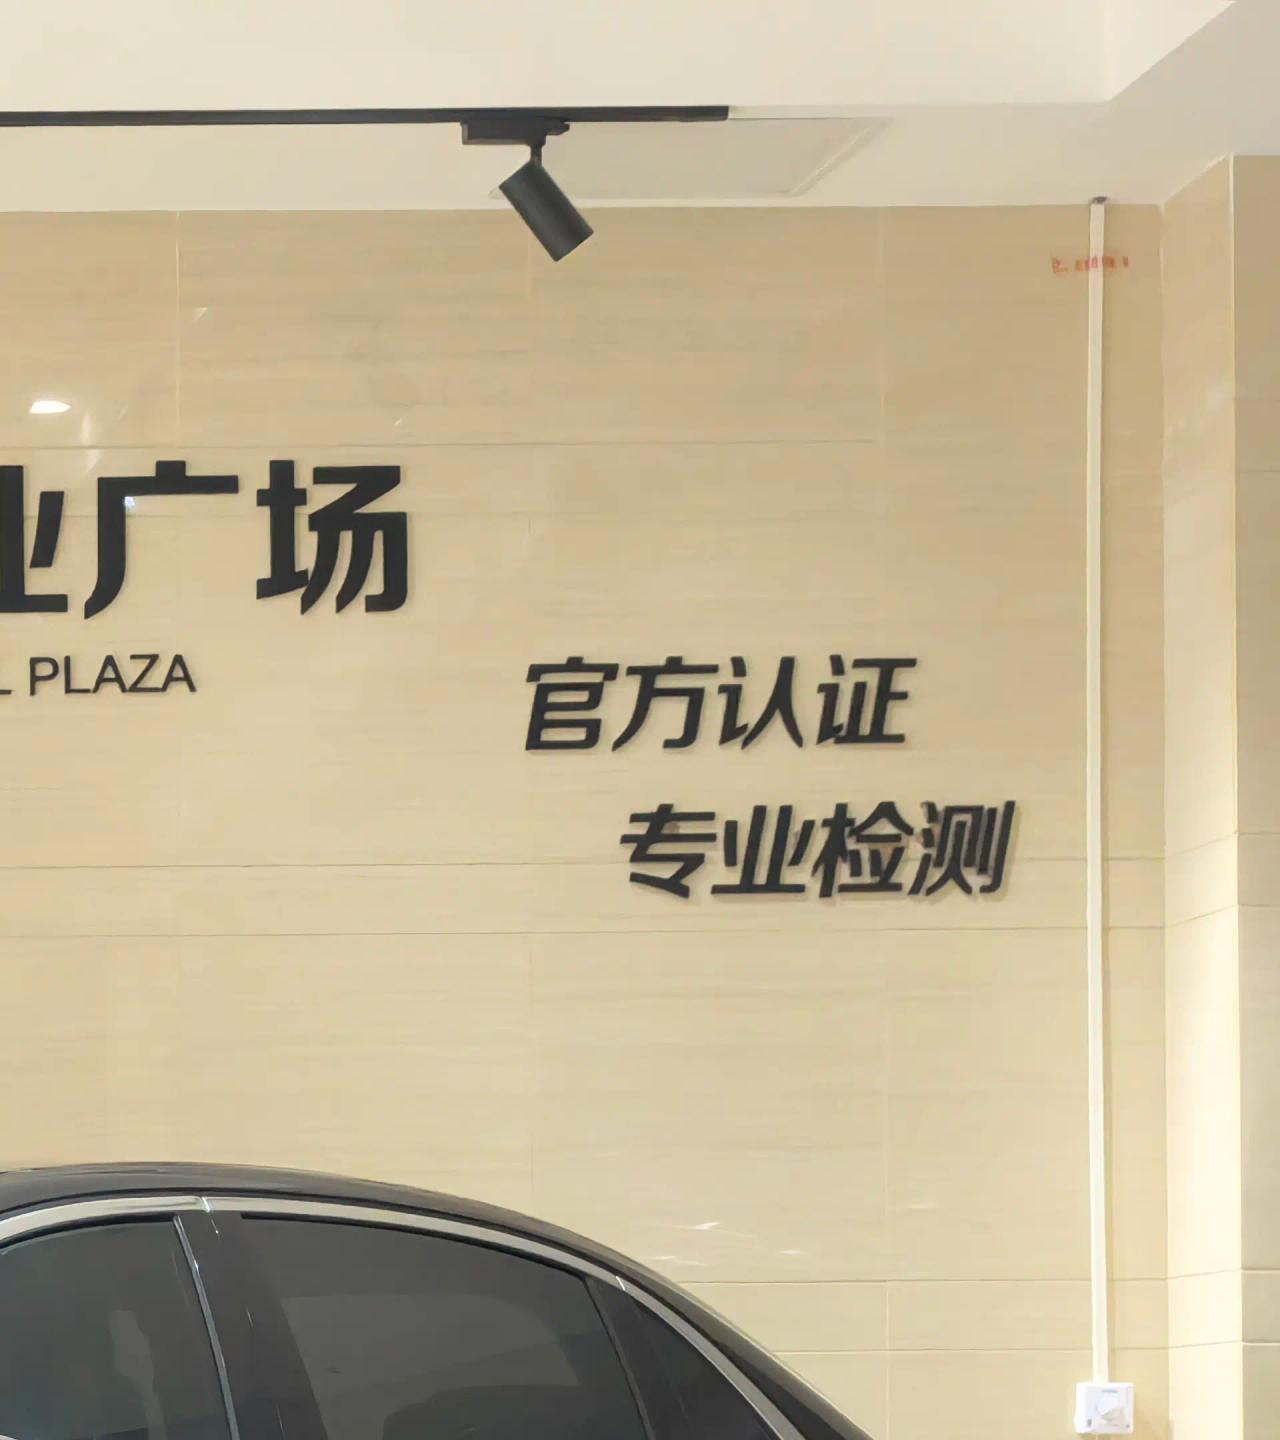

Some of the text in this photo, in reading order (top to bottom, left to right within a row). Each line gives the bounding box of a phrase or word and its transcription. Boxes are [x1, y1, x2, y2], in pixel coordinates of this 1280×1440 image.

[29, 653, 197, 697] PLAZA
[525, 654, 917, 752] 官方认证
[620, 801, 1016, 899] 专业检测
